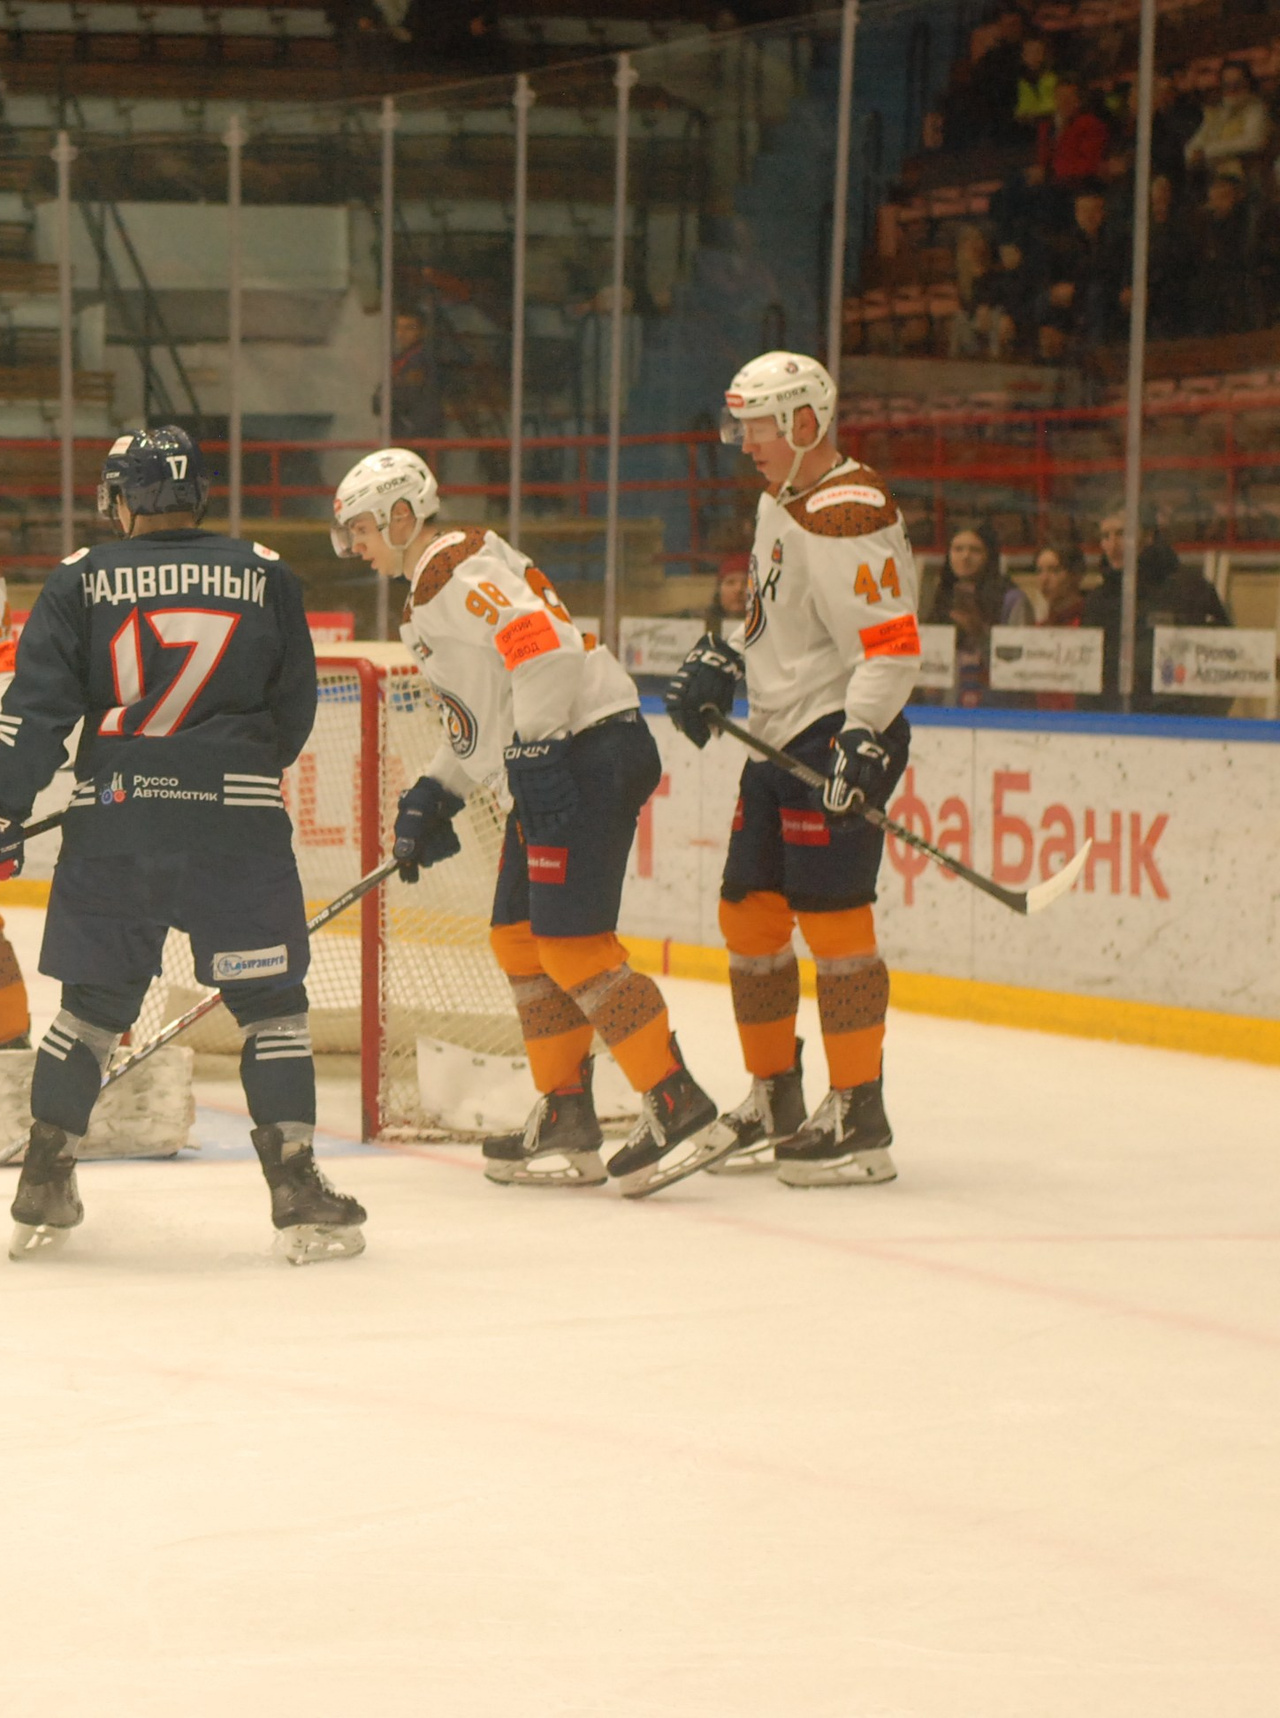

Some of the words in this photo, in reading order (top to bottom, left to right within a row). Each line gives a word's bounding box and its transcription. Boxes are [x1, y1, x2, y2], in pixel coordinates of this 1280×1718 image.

[166, 455, 187, 480] 17
[81, 563, 267, 608] НАДВОРНЫЙ
[854, 556, 901, 604] 44
[465, 581, 512, 626] 98
[97, 606, 242, 737] 17
[132, 788, 218, 802] Автоматик
[133, 774, 179, 790] Руссо
[992, 770, 1171, 901] Банк
